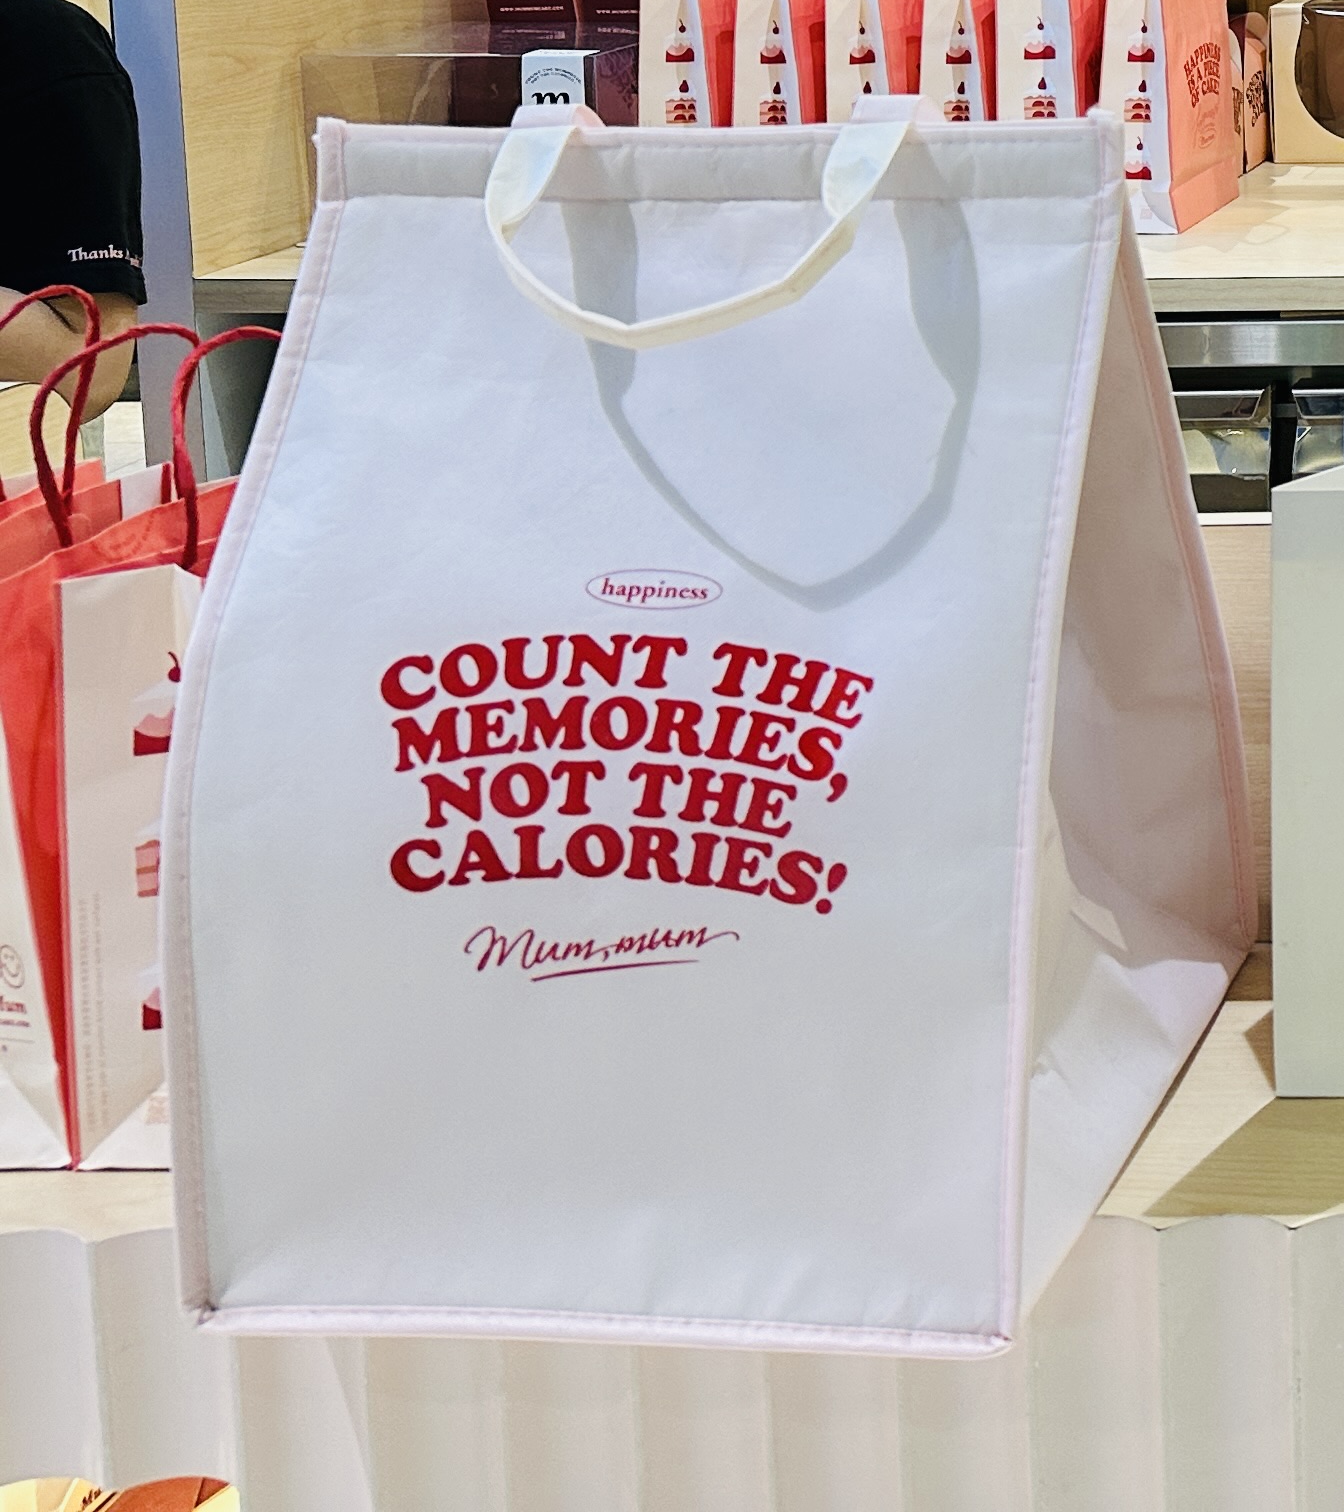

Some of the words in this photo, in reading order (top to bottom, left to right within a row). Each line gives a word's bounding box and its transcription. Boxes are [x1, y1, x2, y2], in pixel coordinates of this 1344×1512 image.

[1184, 41, 1221, 78] HAPPINESS
[67, 244, 124, 262] Thanks
[601, 577, 709, 603] happiness
[380, 633, 688, 711] COUNT
[712, 641, 874, 729] THE
[392, 695, 848, 803] MEMORIES,
[420, 760, 607, 829] NOT
[627, 761, 798, 839] THE
[389, 823, 848, 916] CALORIES!
